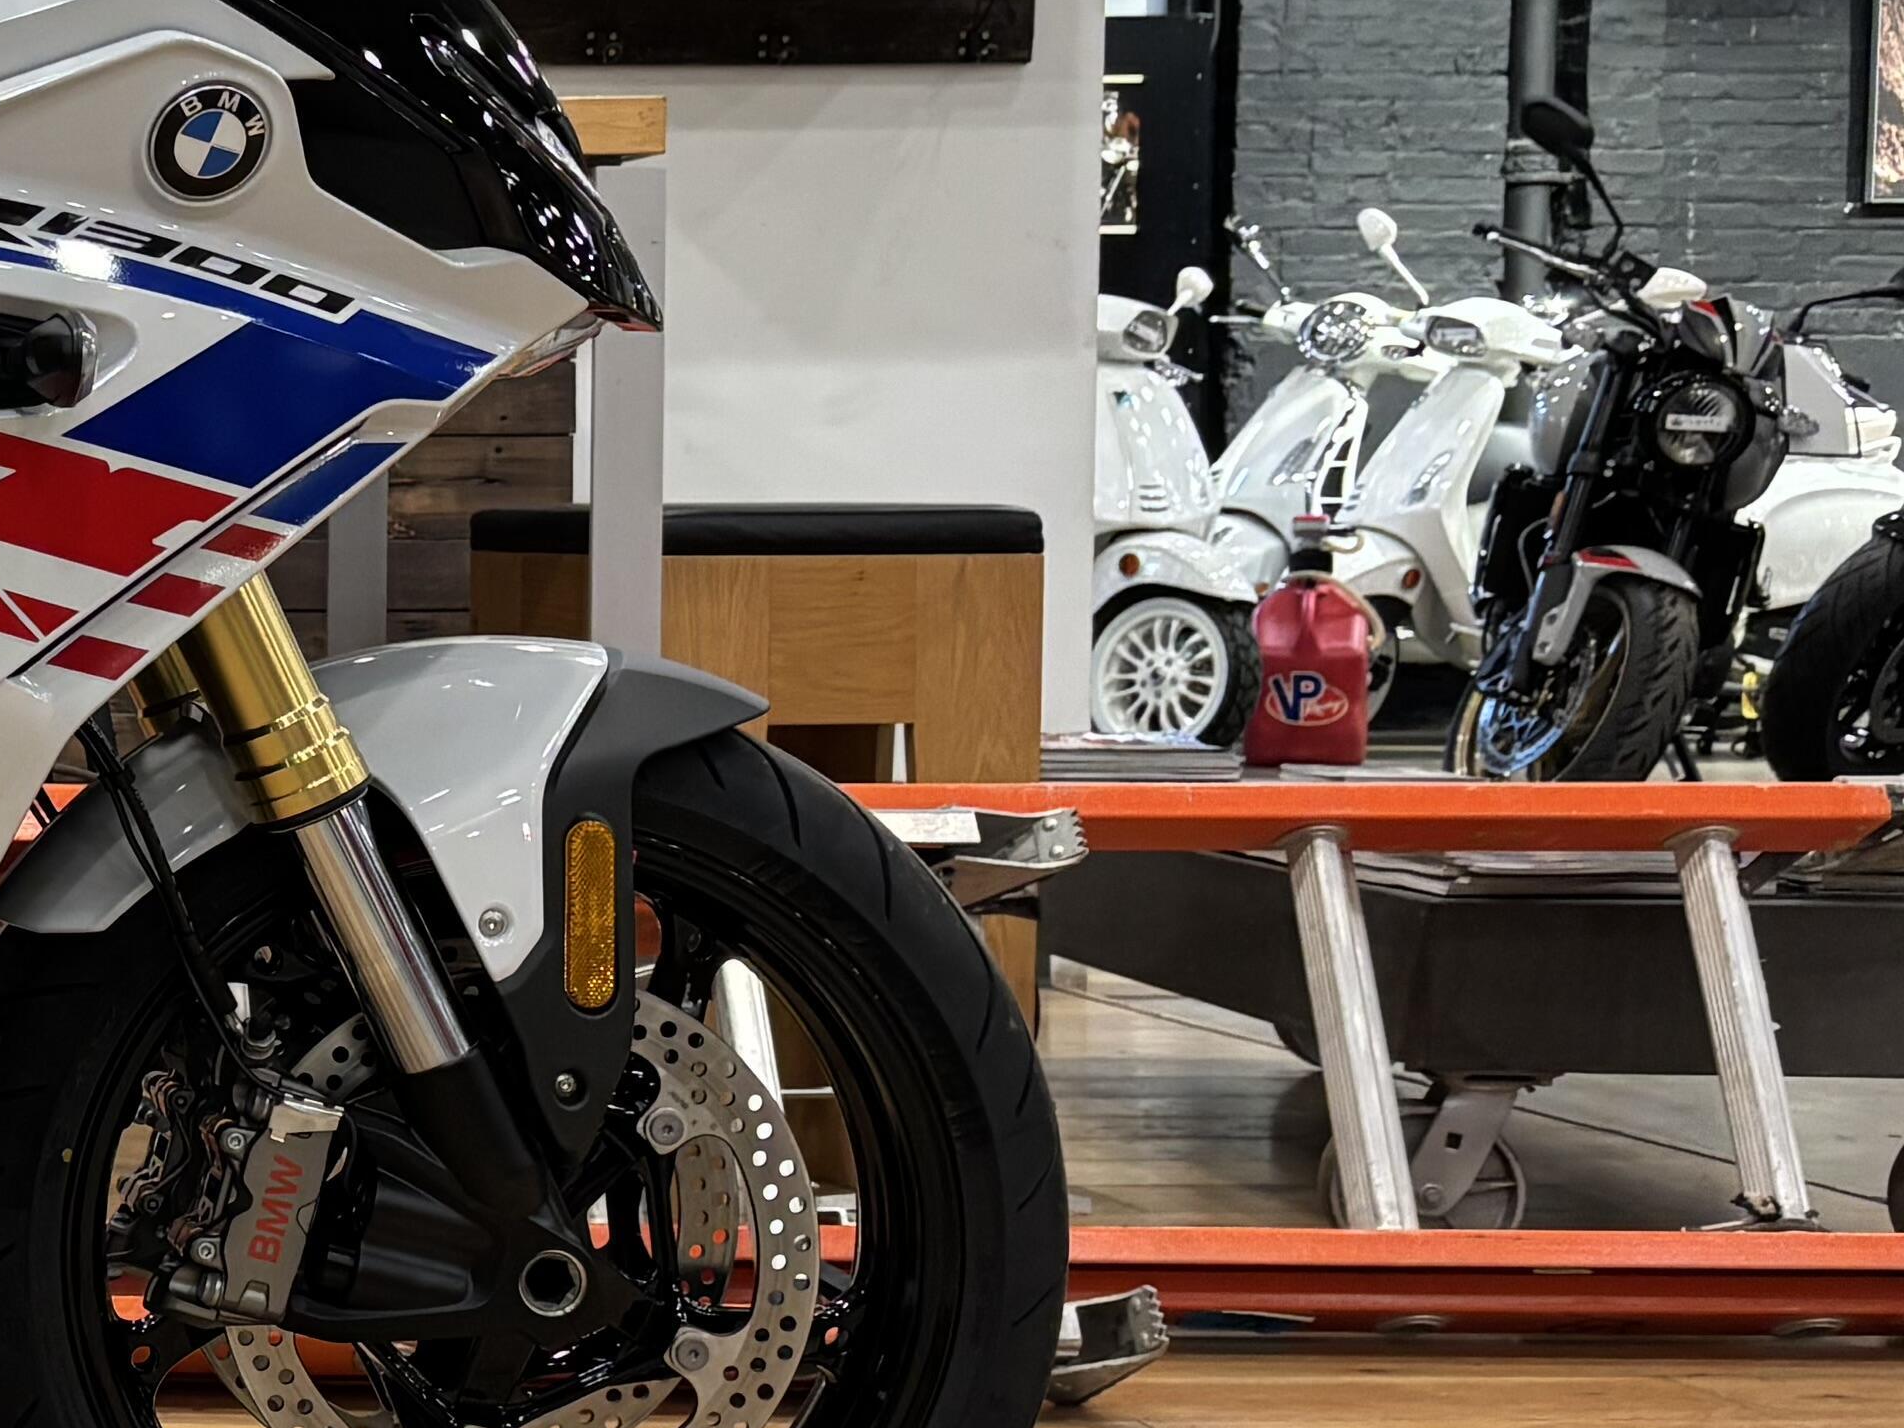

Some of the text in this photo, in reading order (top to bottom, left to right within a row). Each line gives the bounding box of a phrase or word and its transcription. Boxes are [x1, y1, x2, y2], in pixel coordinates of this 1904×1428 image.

[179, 90, 266, 138] BMW
[1269, 671, 1327, 723] VP
[248, 1153, 305, 1264] BMW
